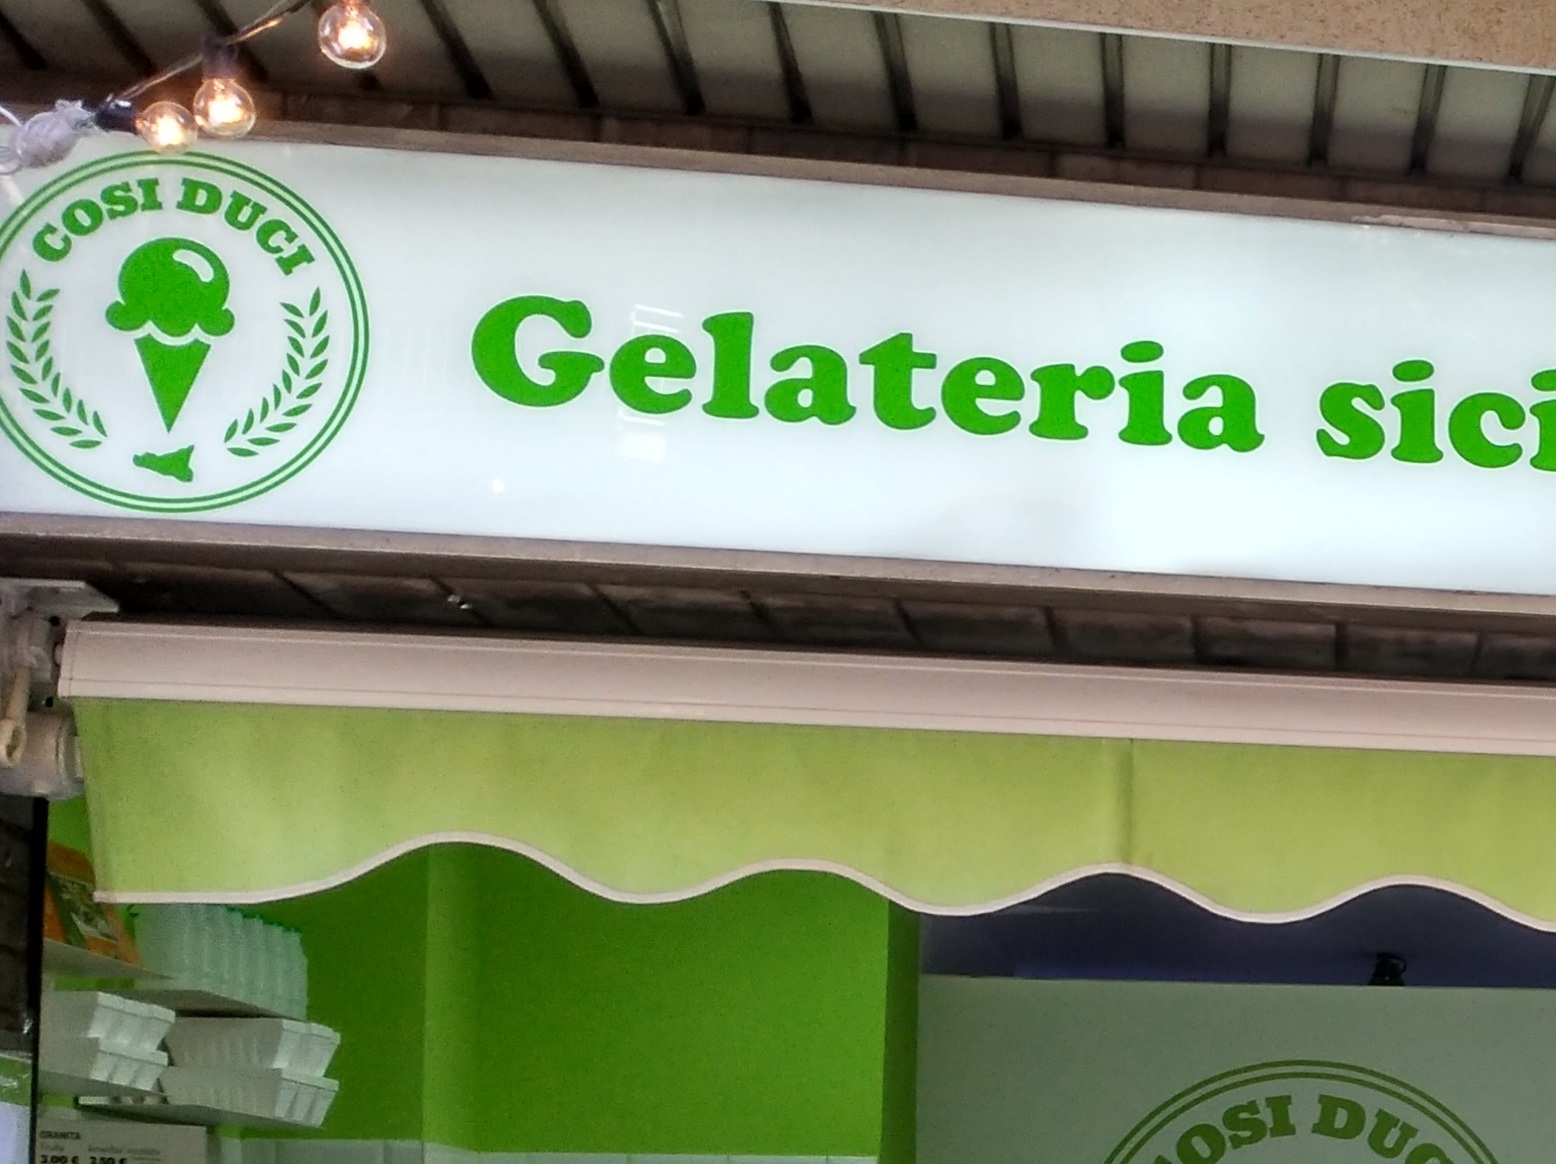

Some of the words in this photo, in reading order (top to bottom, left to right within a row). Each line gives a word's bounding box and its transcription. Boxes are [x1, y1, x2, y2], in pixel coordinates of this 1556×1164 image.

[32, 177, 163, 264] COSI
[175, 177, 315, 276] DUCI
[471, 294, 1265, 453] Gelateria
[71, 1155, 79, 1164] €
